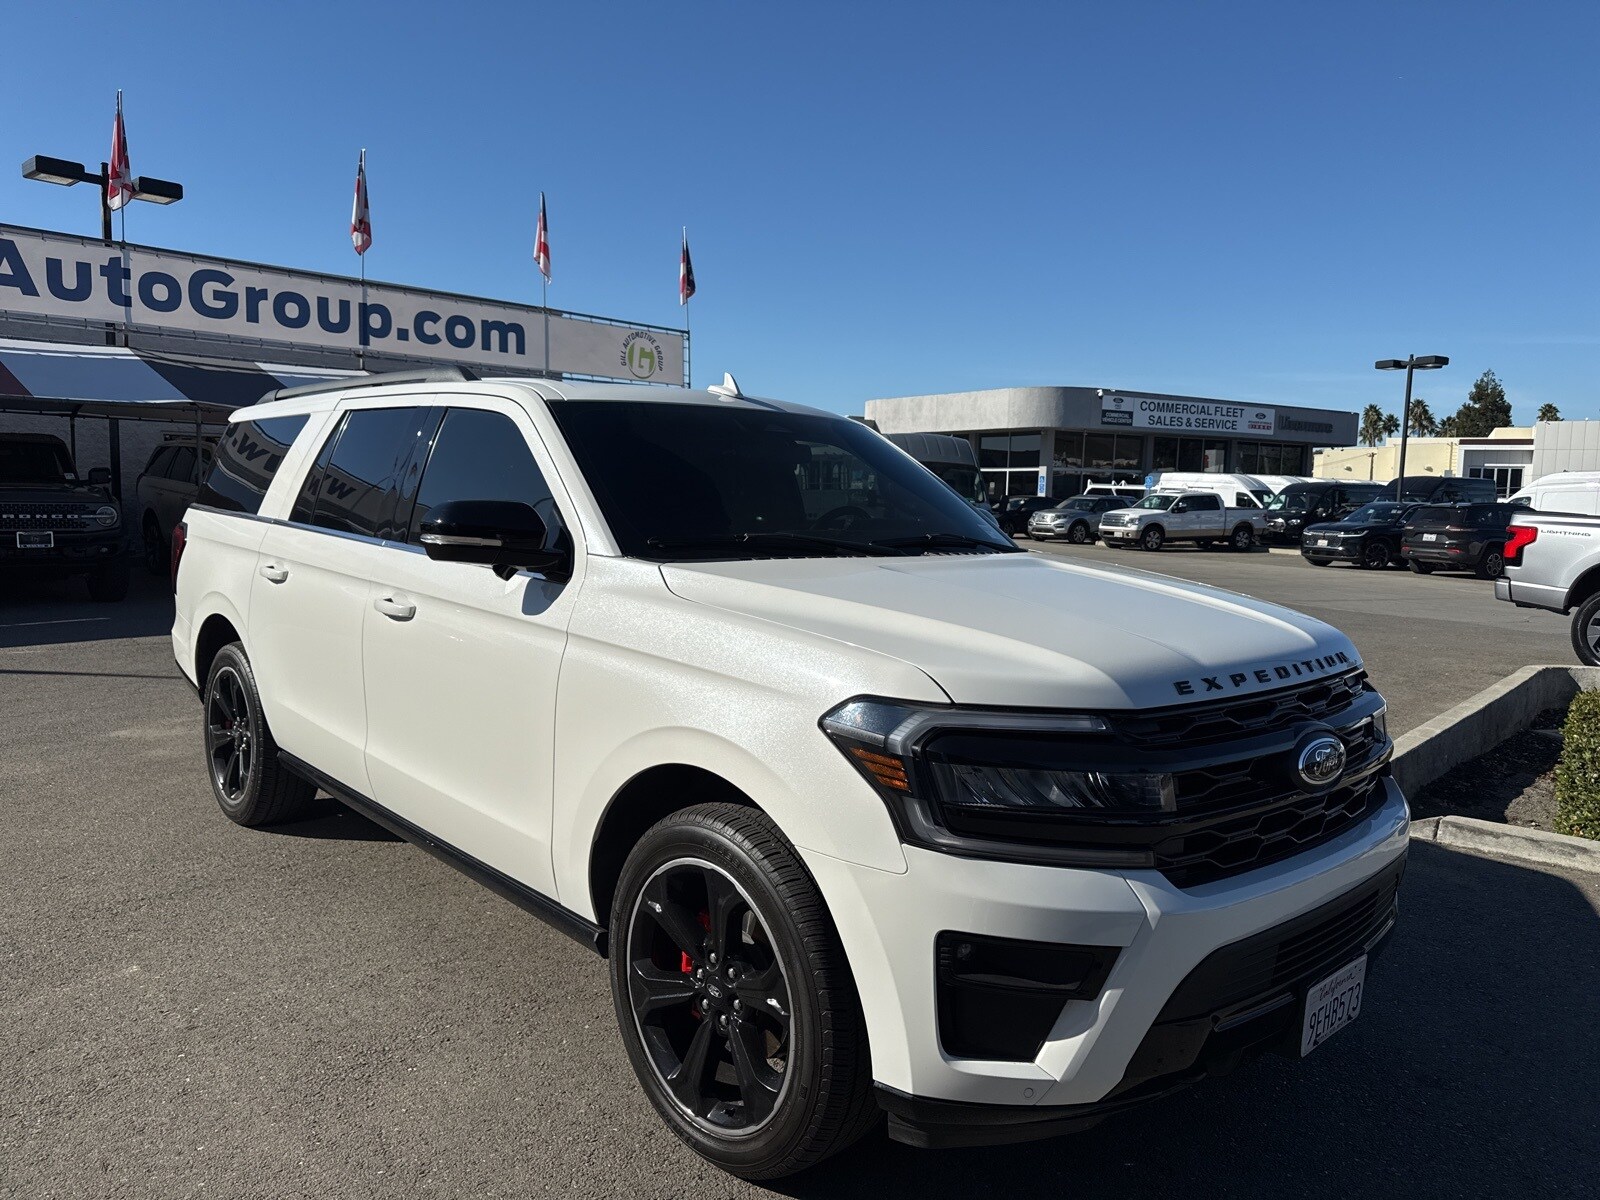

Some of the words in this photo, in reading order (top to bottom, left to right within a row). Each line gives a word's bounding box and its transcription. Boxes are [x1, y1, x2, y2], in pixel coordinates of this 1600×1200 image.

[0, 238, 526, 355] AutoGroup.com
[622, 331, 656, 349] AUTOMOTIVE
[654, 345, 664, 372] GROUP
[1140, 400, 1212, 416] COMMERCIAL
[1214, 406, 1245, 418] FLEET
[1148, 415, 1183, 427] SALES
[1185, 417, 1192, 428] &
[1194, 418, 1238, 430] SERVICE
[1541, 529, 1592, 537] LIGHTNING
[1173, 651, 1350, 696] EXPEDITION
[1307, 981, 1362, 1047] 9EHB573
